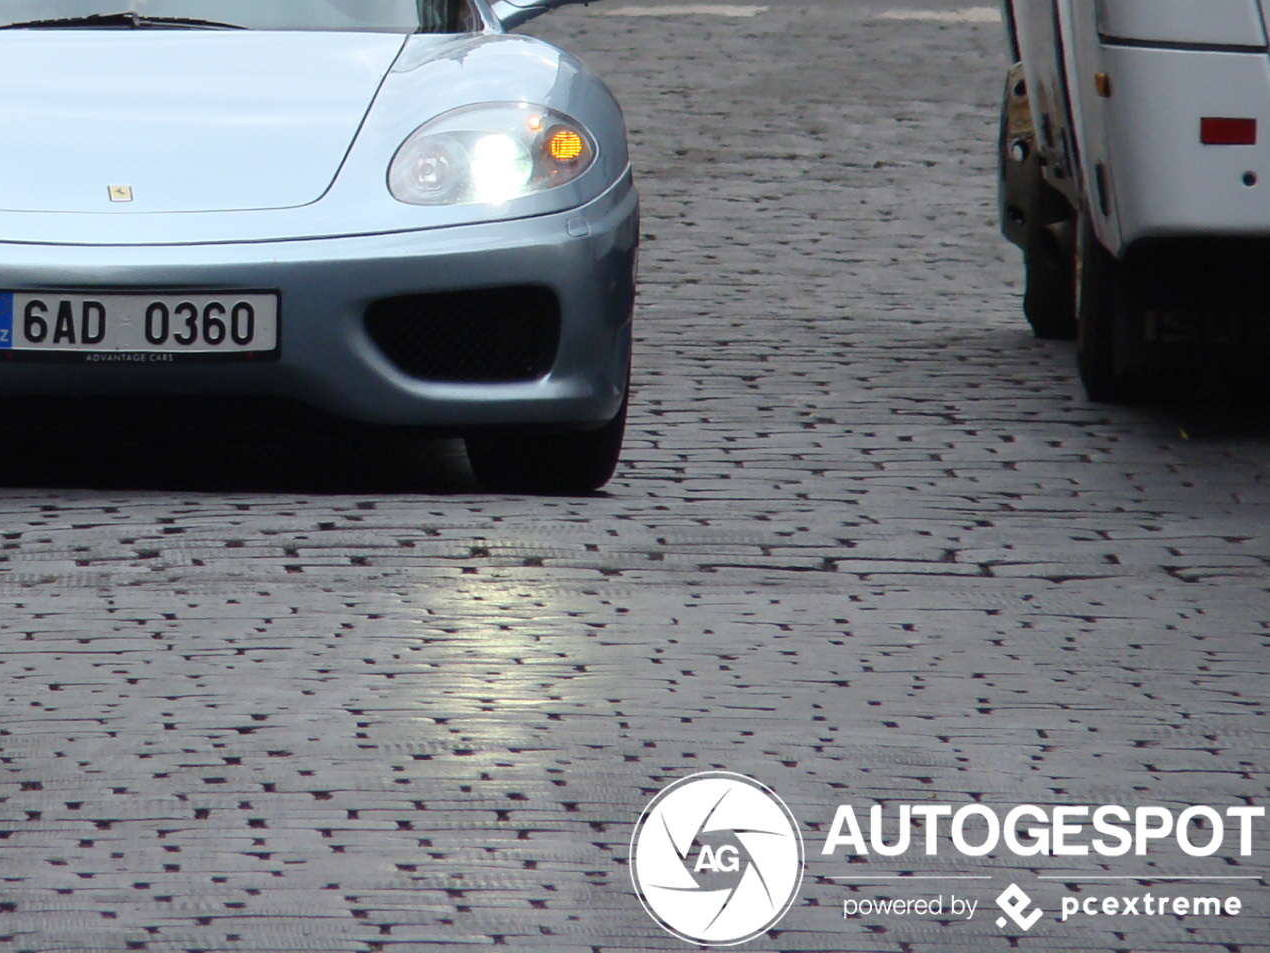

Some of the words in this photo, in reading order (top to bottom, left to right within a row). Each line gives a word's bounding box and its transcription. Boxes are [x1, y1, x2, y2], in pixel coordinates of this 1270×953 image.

[23, 300, 107, 345] 6AD
[145, 301, 255, 346] 0360
[86, 353, 146, 363] ADVANTAGE
[149, 353, 174, 363] CARS
